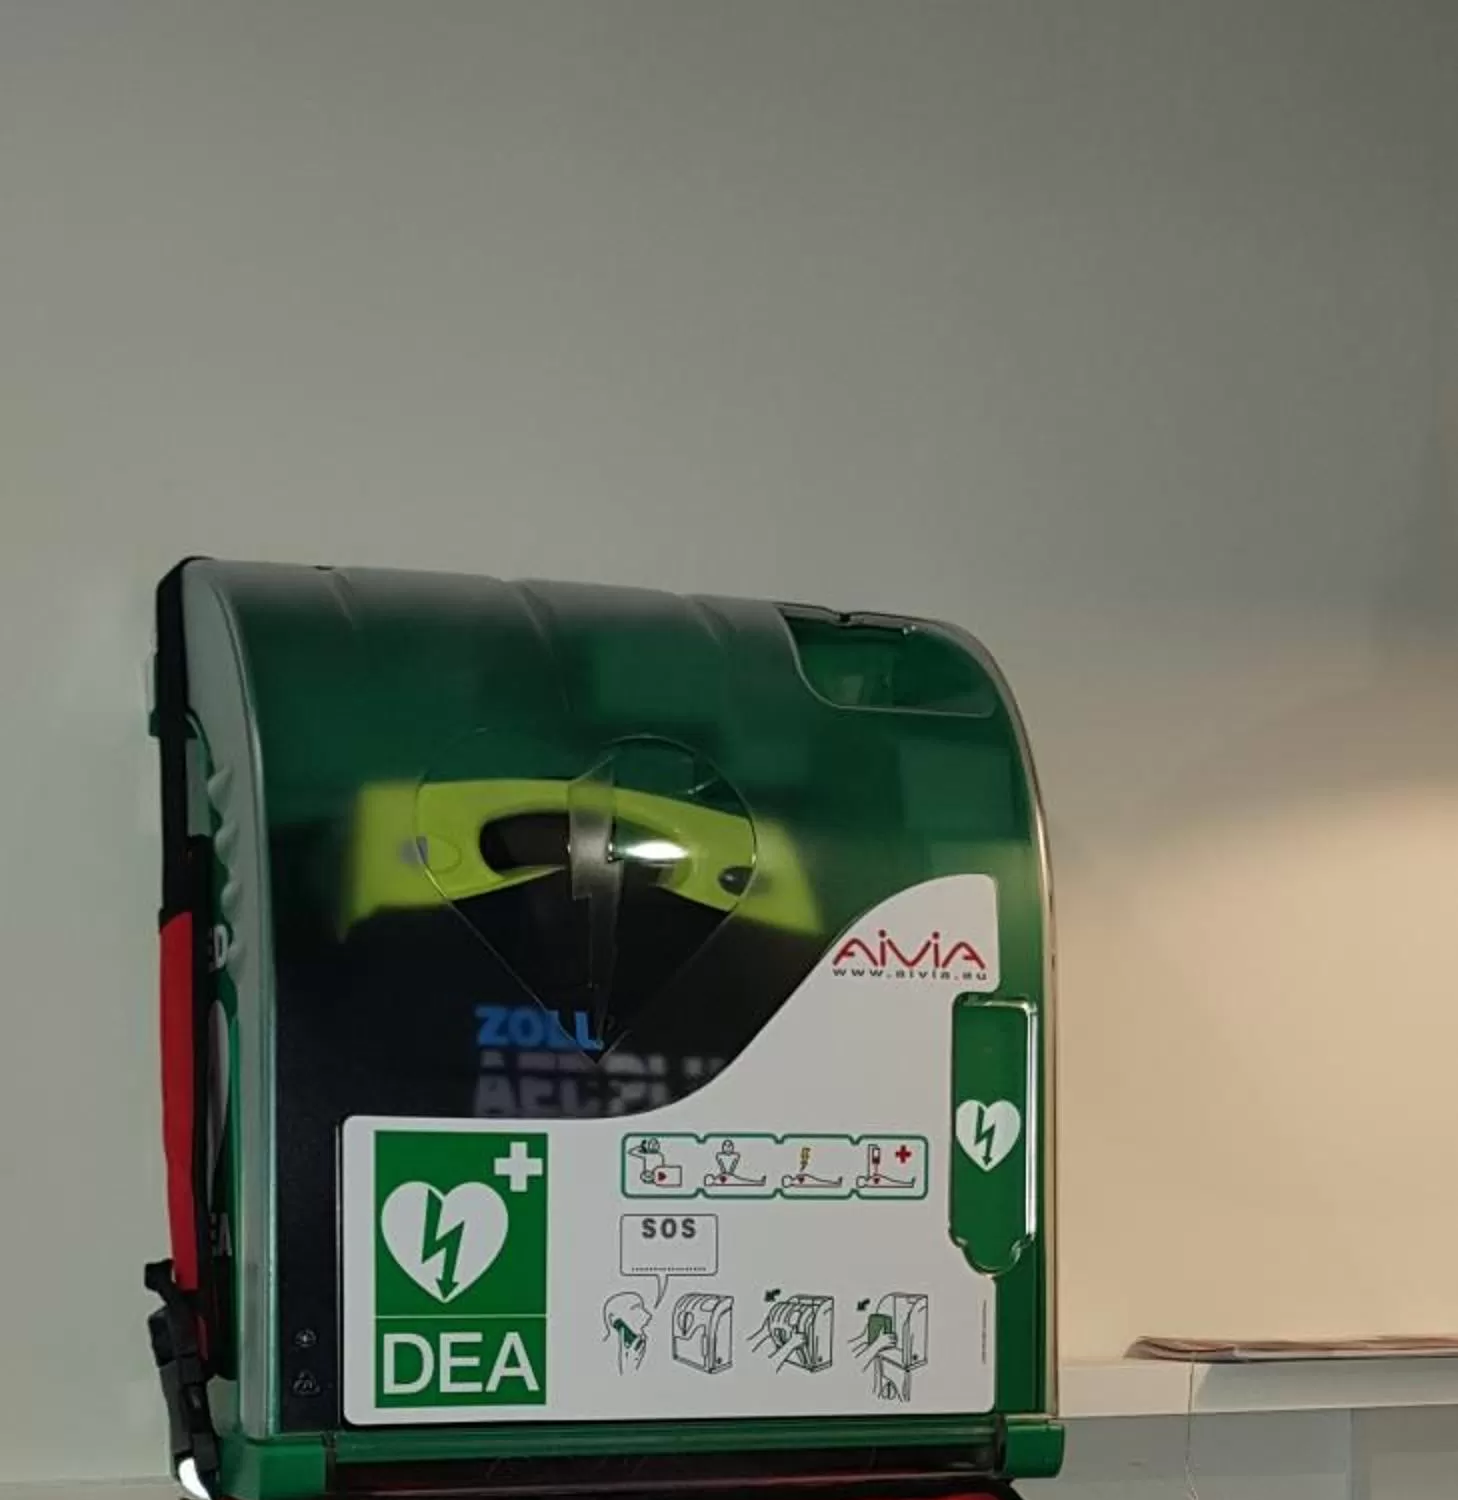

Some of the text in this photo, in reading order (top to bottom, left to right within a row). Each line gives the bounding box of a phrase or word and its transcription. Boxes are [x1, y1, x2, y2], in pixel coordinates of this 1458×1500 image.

[832, 969, 987, 981] www.aivia.eu
[474, 1004, 604, 1051] ZOLL
[641, 1218, 697, 1239] SOS
[383, 1331, 541, 1395] DEA
